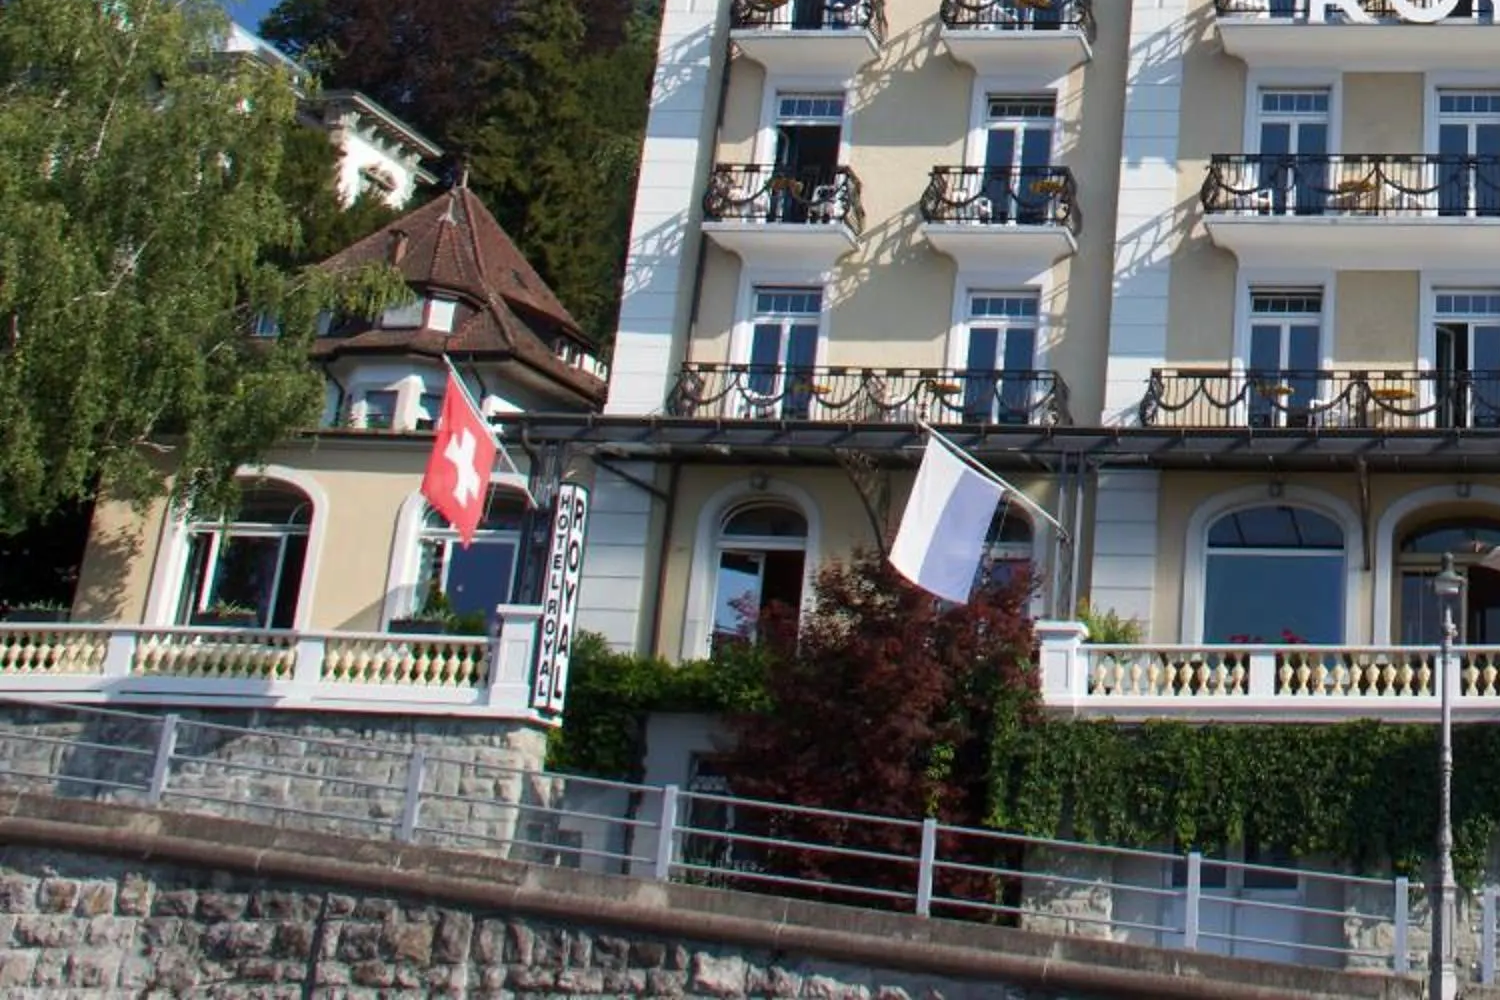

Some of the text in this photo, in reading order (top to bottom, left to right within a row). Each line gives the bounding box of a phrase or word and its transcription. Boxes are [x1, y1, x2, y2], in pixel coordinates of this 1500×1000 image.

[538, 494, 571, 698] HOTEL ROYAL
[553, 498, 585, 699] ROYAL
